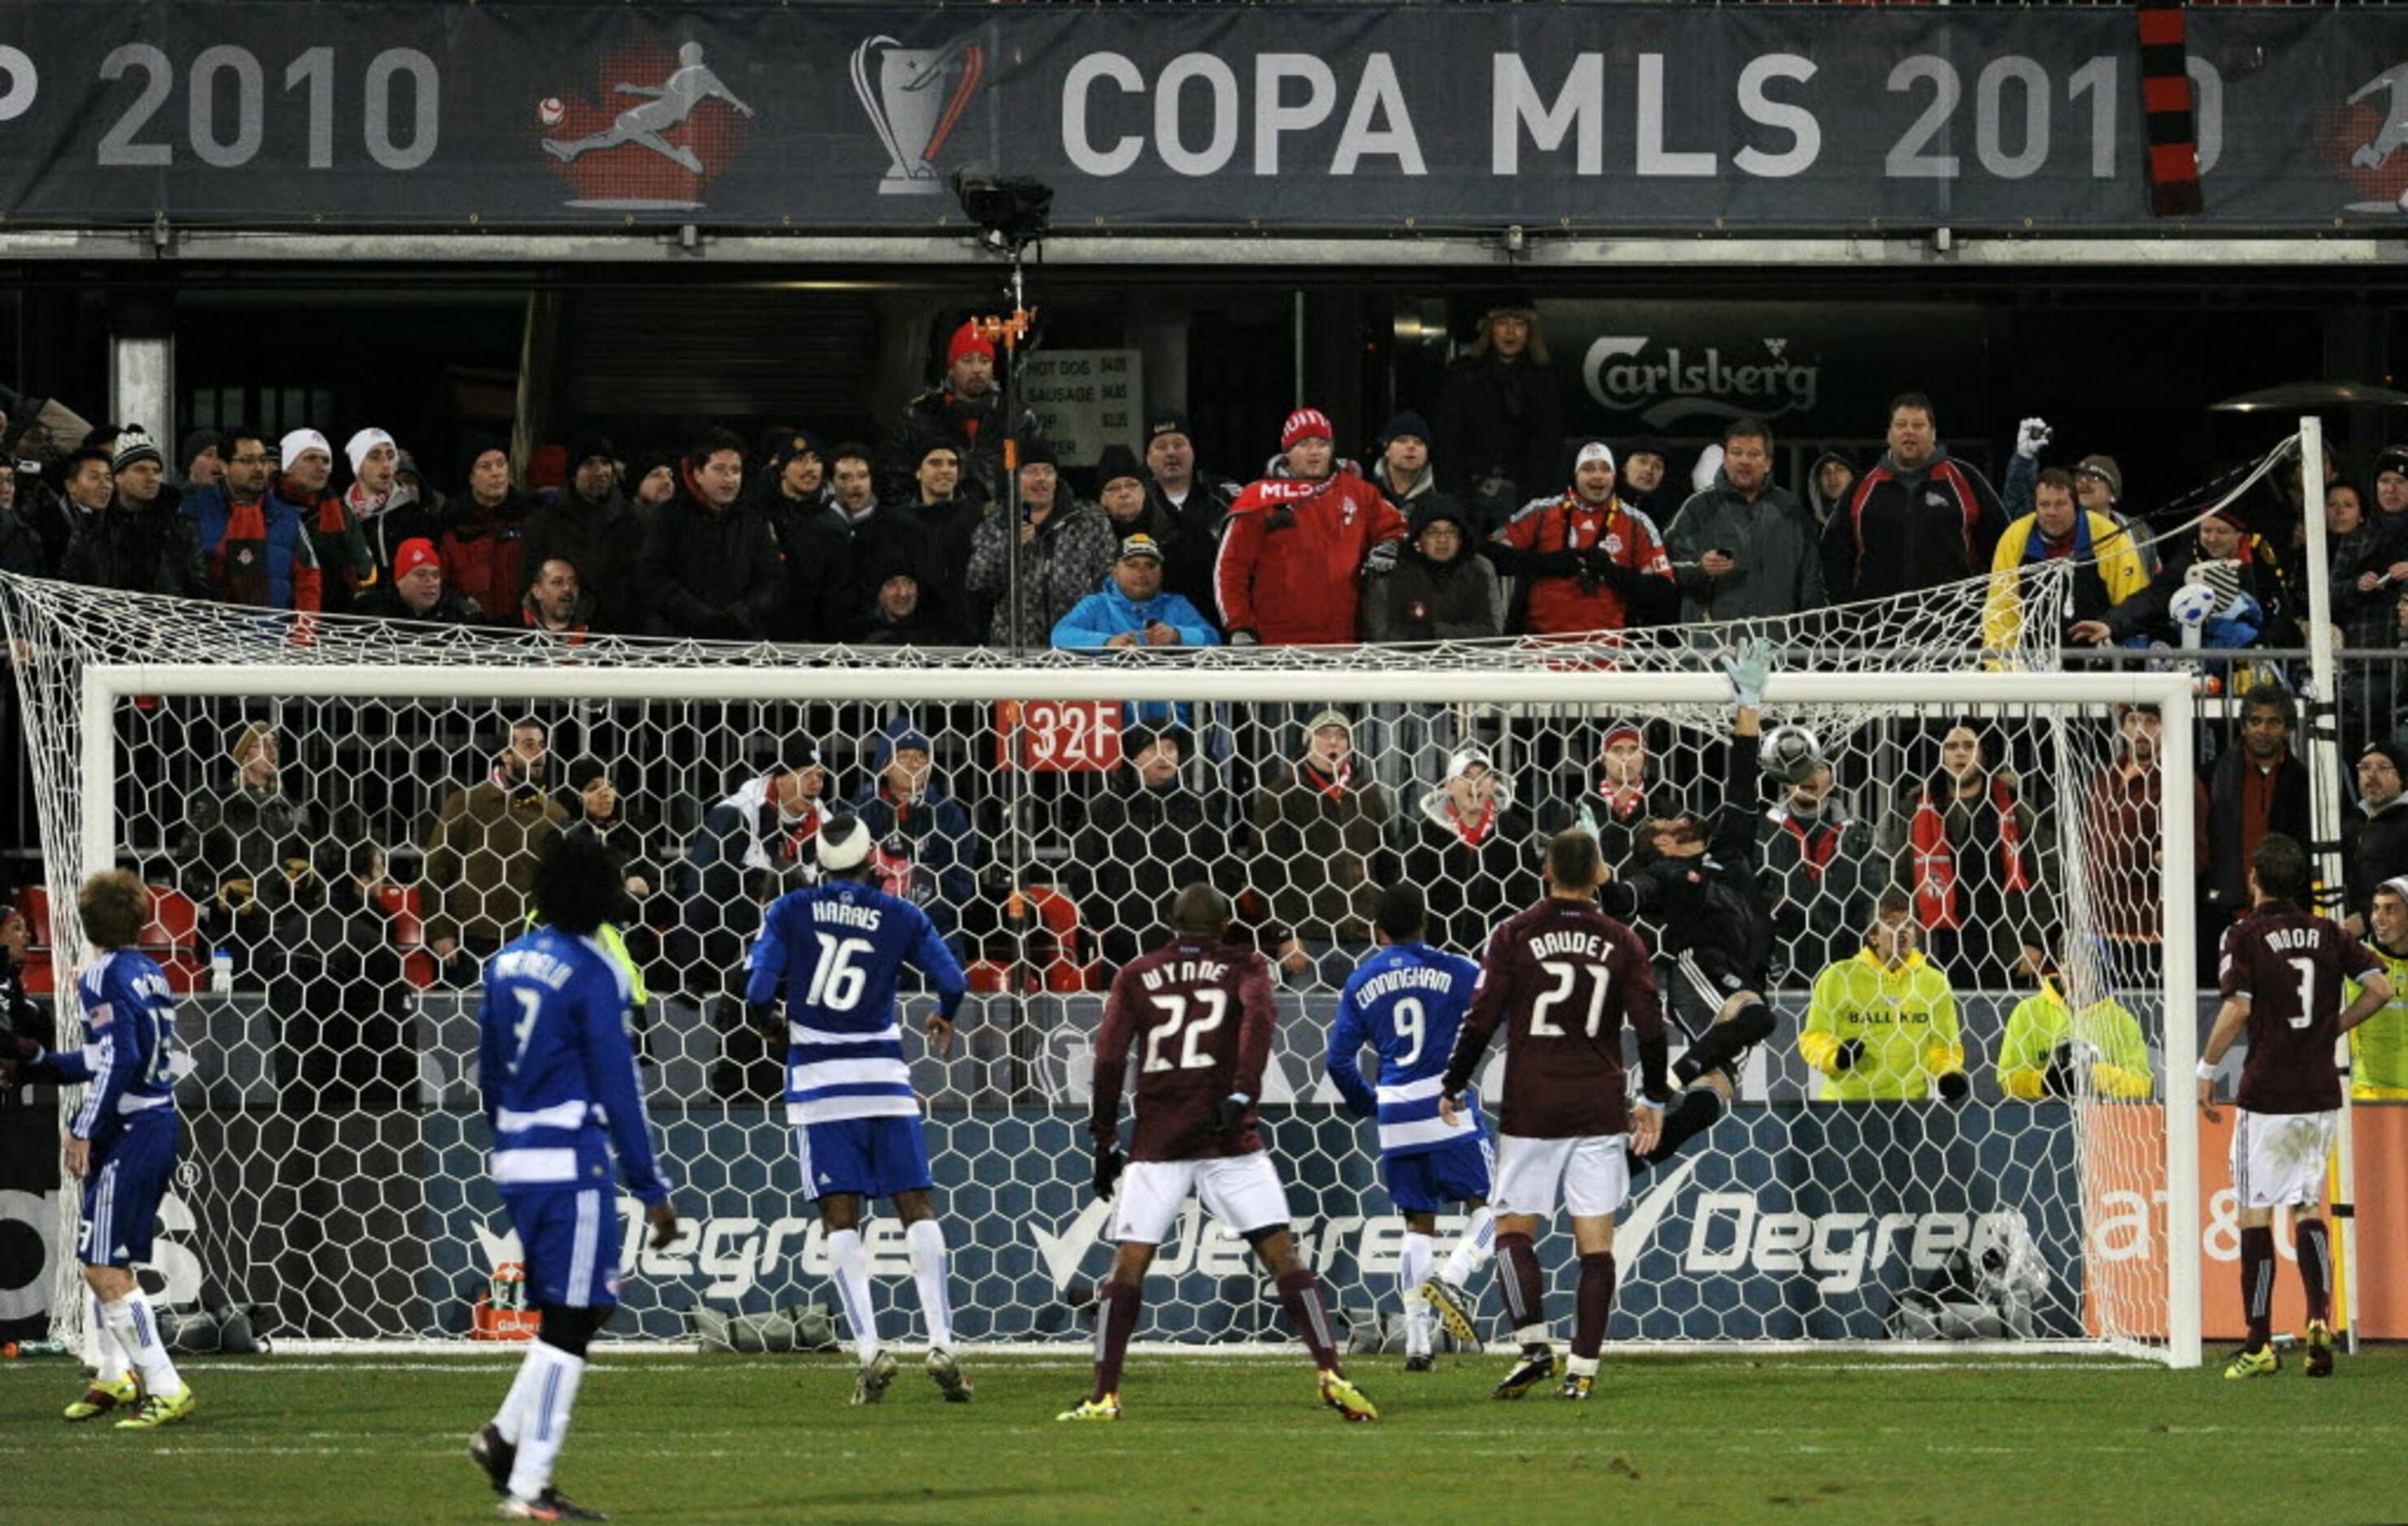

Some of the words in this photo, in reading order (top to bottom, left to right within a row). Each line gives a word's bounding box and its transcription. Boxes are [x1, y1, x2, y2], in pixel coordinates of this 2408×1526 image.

[98, 43, 440, 170] 2010
[1061, 50, 1428, 176] COPA
[1492, 52, 1821, 177] MLS
[1028, 387, 1095, 402] SAUSAGE
[1581, 336, 1819, 411] Carlsberg
[1032, 707, 1116, 760] 32F
[812, 900, 883, 932] HARRIS
[1528, 931, 1615, 962] BAUDET
[806, 930, 875, 1012] 16
[1141, 960, 1229, 991] WYNNE
[1356, 965, 1452, 1010] CUNNINGHAM
[2287, 956, 2315, 1030] 3
[1143, 988, 1227, 1073] 22
[1393, 996, 1426, 1067] 9
[1849, 1012, 1892, 1023] BALL
[1900, 1012, 1929, 1023] KID
